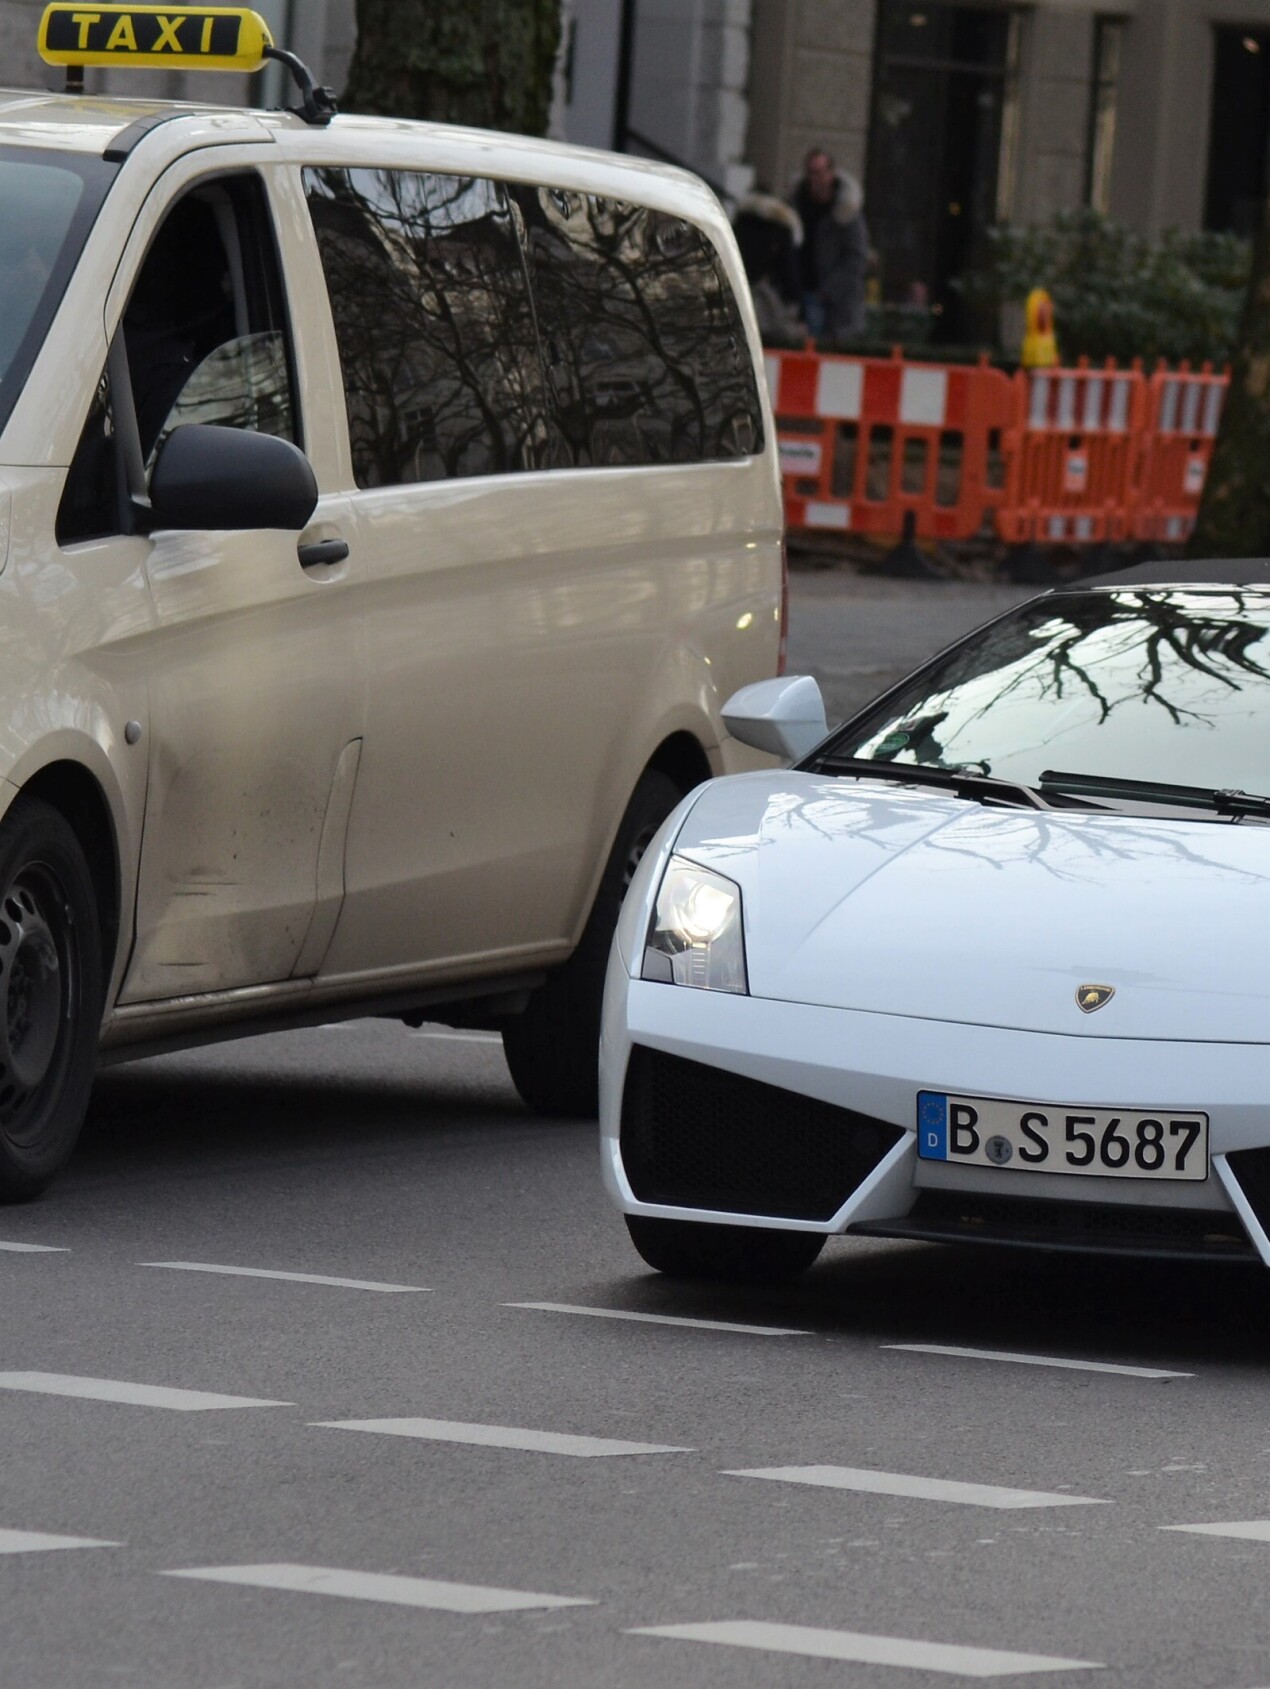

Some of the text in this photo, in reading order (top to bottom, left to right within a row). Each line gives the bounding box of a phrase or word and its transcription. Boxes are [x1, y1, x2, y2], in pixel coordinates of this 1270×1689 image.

[72, 13, 214, 52] TAXI
[927, 1132, 938, 1147] D
[950, 1103, 1201, 1171] B S 5687
